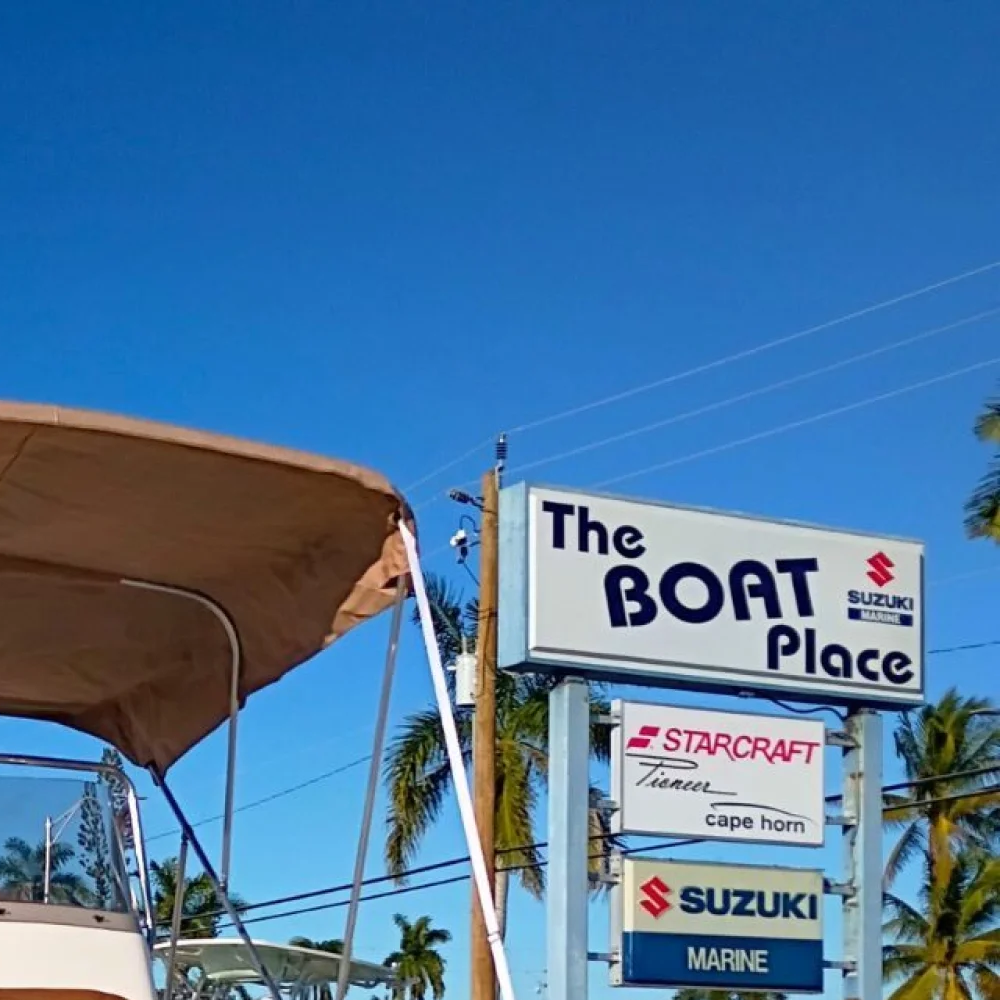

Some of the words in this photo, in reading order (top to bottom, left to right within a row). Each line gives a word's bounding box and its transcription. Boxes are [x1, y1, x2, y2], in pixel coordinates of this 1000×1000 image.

[542, 500, 647, 559] The
[604, 557, 819, 628] BOAT
[848, 590, 914, 611] SUZUKI
[861, 608, 900, 624] MARINE
[767, 624, 914, 684] Place
[663, 727, 820, 764] STARCRAFT
[625, 752, 737, 795] Pioneer
[705, 813, 754, 832] cape
[760, 814, 806, 833] horn
[680, 885, 818, 920] SUZUKI
[687, 946, 769, 973] MARINE
